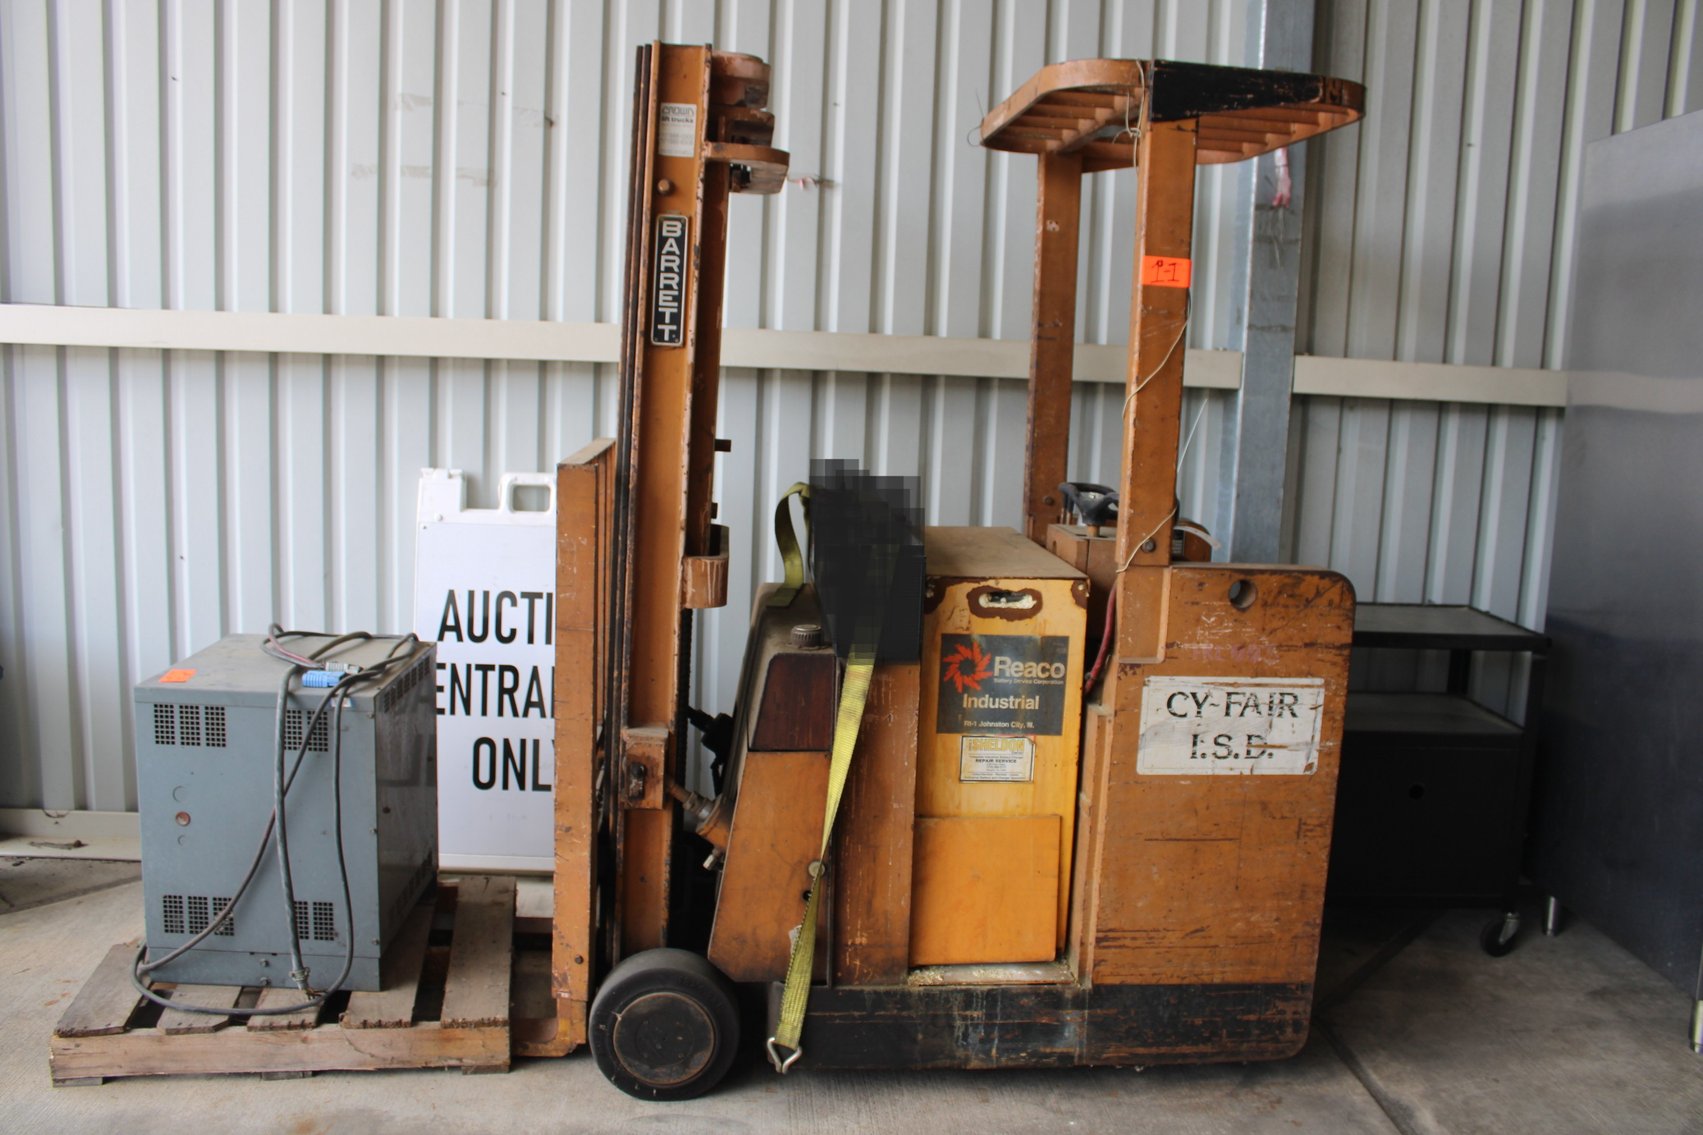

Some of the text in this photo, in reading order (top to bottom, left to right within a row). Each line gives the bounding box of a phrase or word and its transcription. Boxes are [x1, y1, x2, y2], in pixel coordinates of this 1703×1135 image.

[657, 220, 682, 341] BARRETT
[437, 588, 553, 645] AUCTI
[993, 656, 1066, 679] Reaco
[436, 662, 555, 718] ENTRA
[962, 693, 1040, 710] Industrial
[979, 720, 1010, 728] Johnston
[472, 737, 555, 792] ONL
[1190, 733, 1274, 760] I.S.D.
